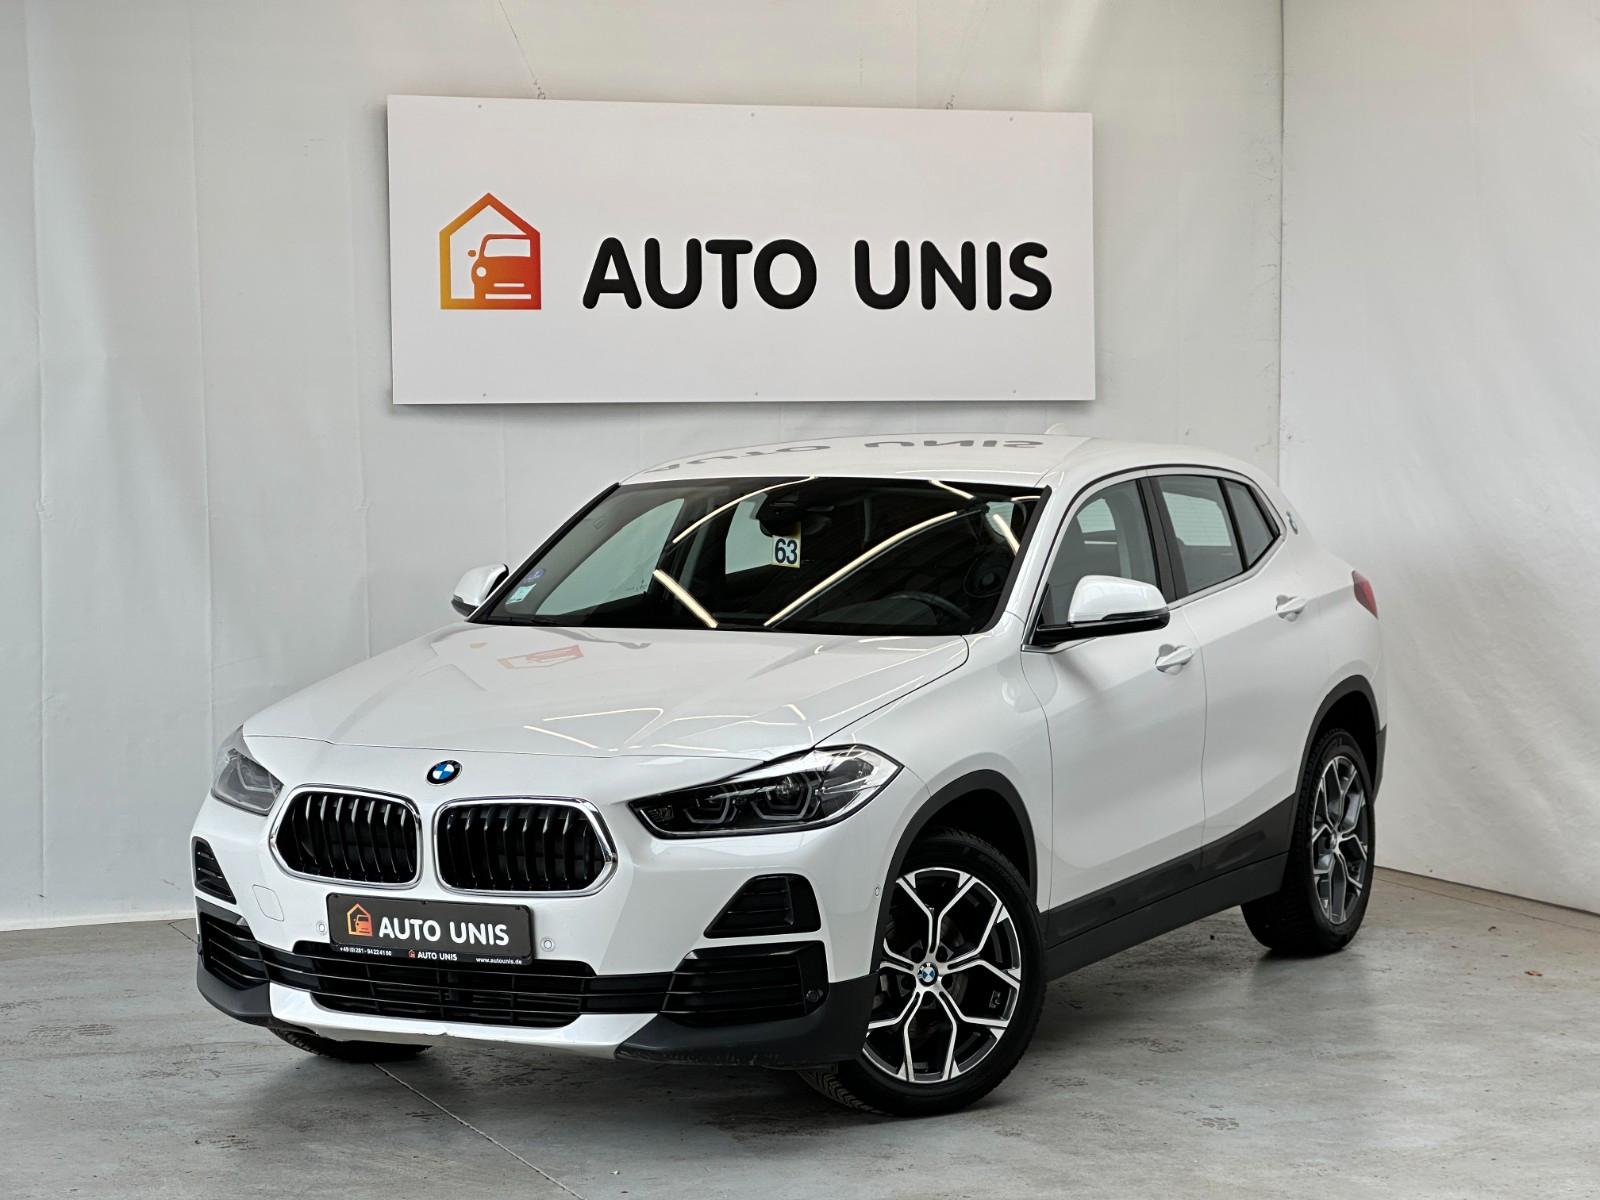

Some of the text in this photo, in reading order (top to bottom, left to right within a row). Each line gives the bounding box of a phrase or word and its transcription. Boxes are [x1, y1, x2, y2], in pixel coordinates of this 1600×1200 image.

[582, 237, 1052, 311] AUTO UNIS
[775, 538, 798, 565] 63
[378, 917, 510, 946] AUTO UNIS
[417, 951, 458, 961] AUTO UNIS
[475, 957, 522, 965] www.autounis.de
